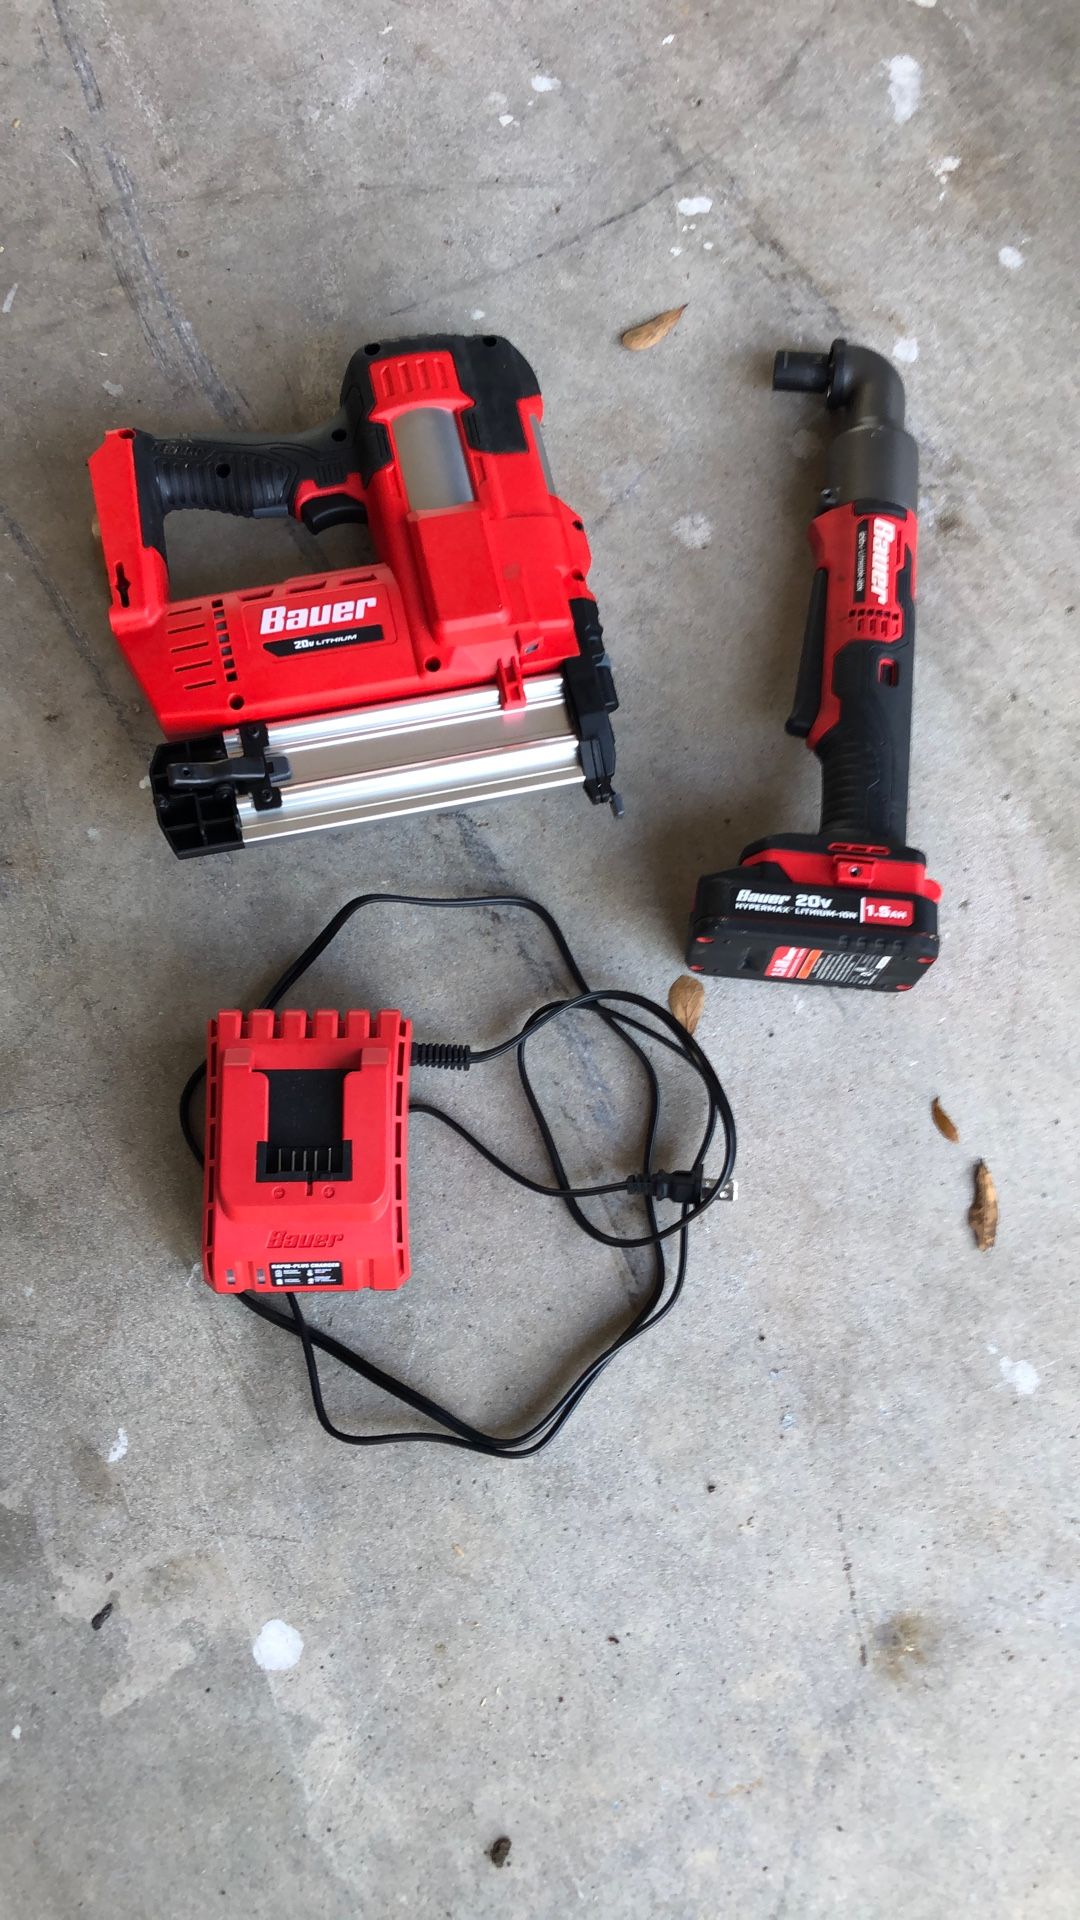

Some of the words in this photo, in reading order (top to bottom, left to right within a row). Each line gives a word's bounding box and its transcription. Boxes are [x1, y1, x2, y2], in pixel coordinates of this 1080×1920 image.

[871, 517, 896, 606] Bauer
[260, 597, 377, 635] Bauer
[315, 634, 358, 647] LITHIUM
[735, 889, 791, 905] Bauer
[794, 907, 859, 920] LITHIUM-ION
[266, 1229, 344, 1248] Bauer
